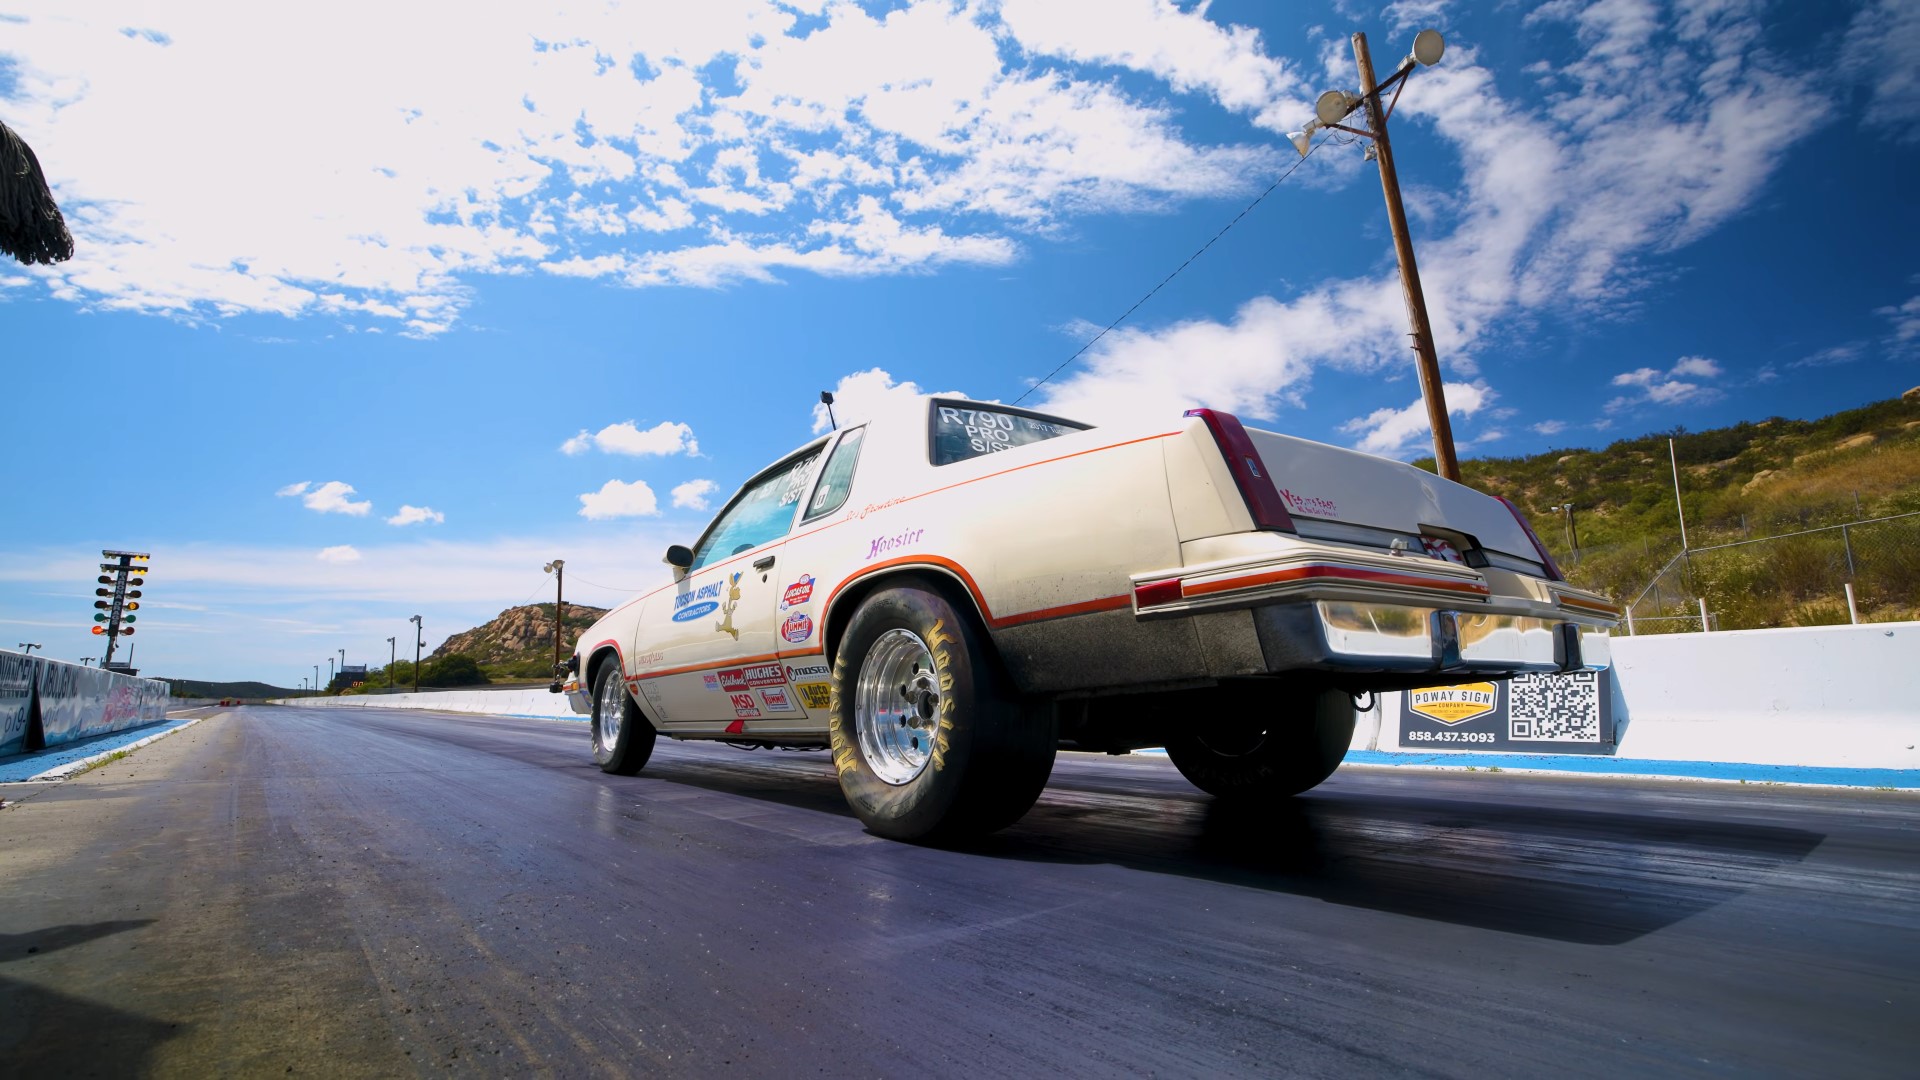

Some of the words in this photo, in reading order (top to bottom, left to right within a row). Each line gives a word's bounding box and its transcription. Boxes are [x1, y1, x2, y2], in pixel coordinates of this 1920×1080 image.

[938, 406, 1014, 431] R790
[965, 425, 1010, 442] PRO
[696, 580, 724, 601] ASPHALT
[785, 616, 808, 638] SUMMIT
[745, 665, 781, 680] HUGHES
[795, 666, 829, 675] MOSER
[721, 674, 747, 686] Edelbrock
[808, 684, 829, 695] Auto
[1415, 691, 1454, 703] POWAY
[1461, 691, 1490, 703] SIGN
[730, 694, 755, 709] MSD
[1408, 731, 1495, 742] 858.437.3093
